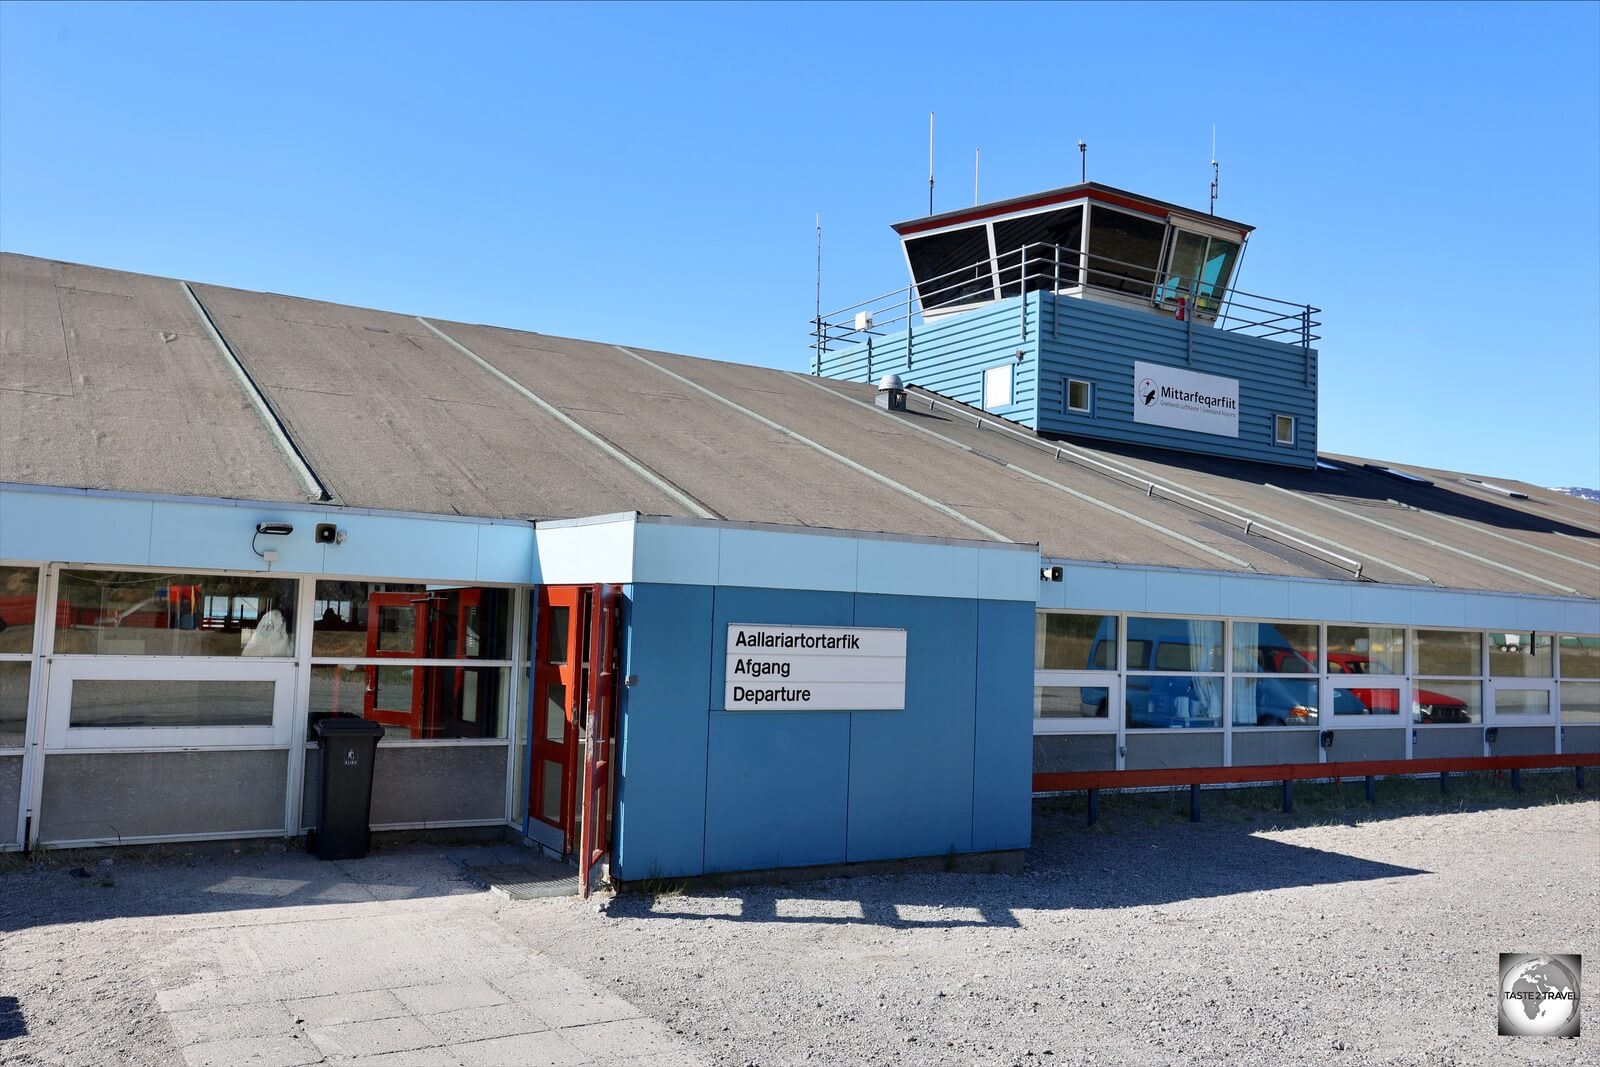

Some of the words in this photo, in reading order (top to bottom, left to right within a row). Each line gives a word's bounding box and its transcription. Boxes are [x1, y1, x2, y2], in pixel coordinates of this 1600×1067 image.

[1161, 386, 1236, 409] Mittarfeqarfiit
[735, 631, 860, 649] Aallariartortarfik
[734, 659, 790, 677] Afgang
[733, 686, 811, 704] Departure
